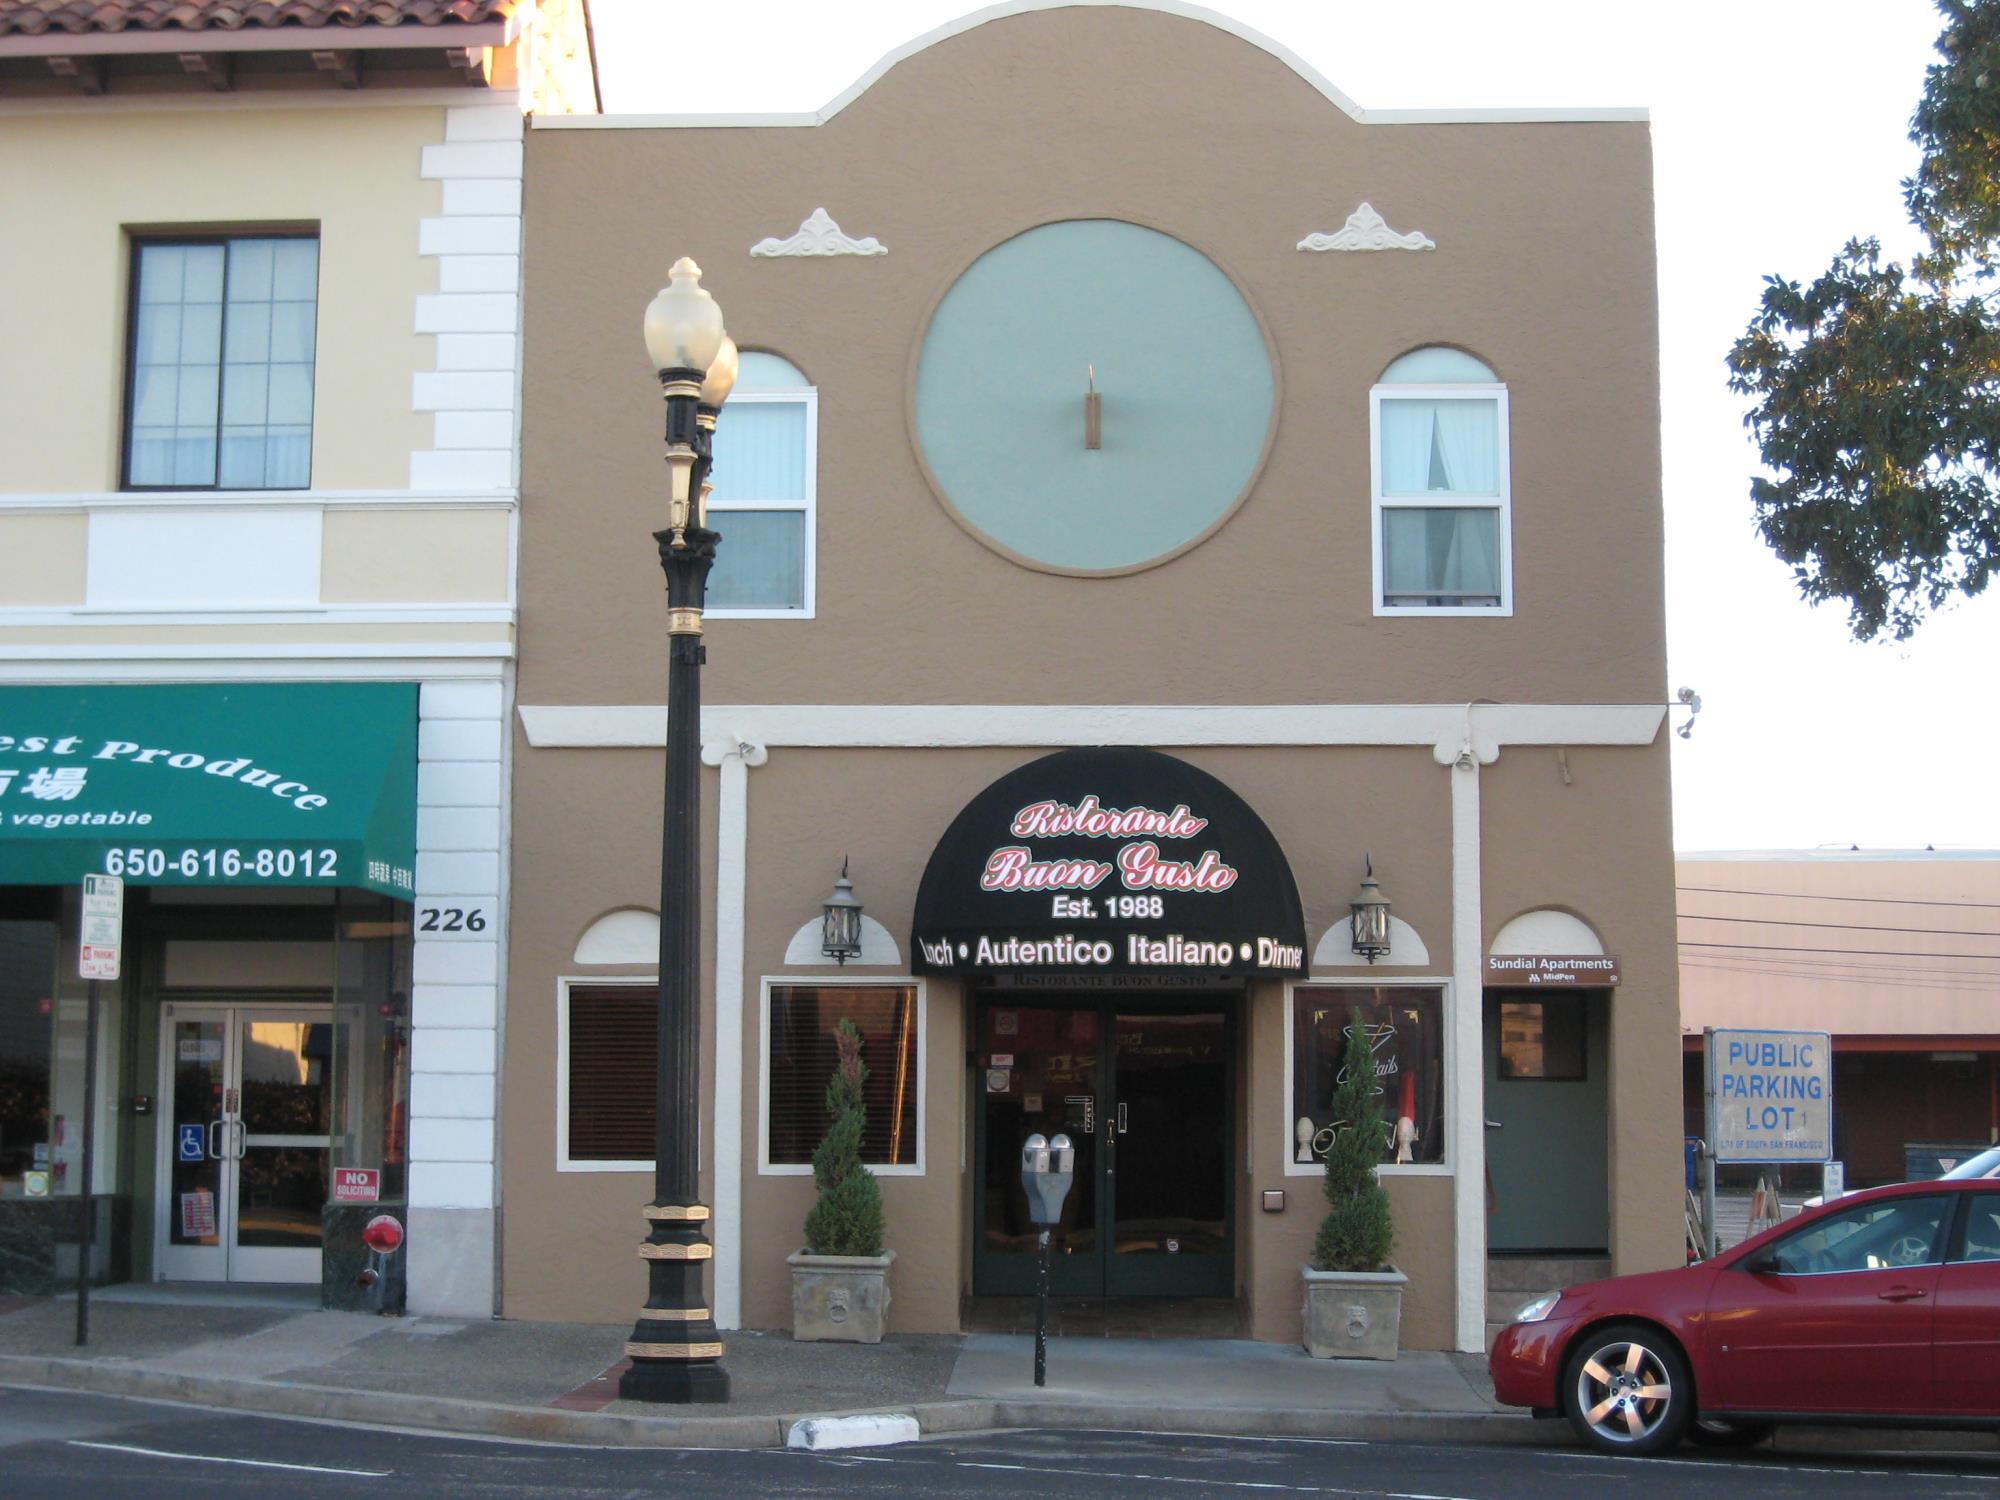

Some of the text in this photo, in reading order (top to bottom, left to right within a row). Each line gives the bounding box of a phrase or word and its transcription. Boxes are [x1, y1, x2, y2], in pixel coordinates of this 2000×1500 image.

[92, 741, 328, 811] Produce
[12, 811, 152, 829] vegetable
[1012, 796, 1207, 838] Ristorante
[105, 848, 338, 878] 650-616-8012
[981, 841, 1237, 892] Buon Gusto
[1052, 896, 1164, 919] Est. 1988
[420, 908, 486, 932] 226
[975, 935, 1114, 966] Autentico
[1127, 934, 1234, 966] Italiano
[1257, 937, 1302, 969] Dinner
[1490, 958, 1614, 972] Sundial Apartments
[1729, 1042, 1813, 1067] PUBLIC
[1722, 1074, 1821, 1099] PARKING
[1746, 1106, 1795, 1130] LOT
[337, 1185, 376, 1195] SOLICITING
[346, 1173, 368, 1184] NO
